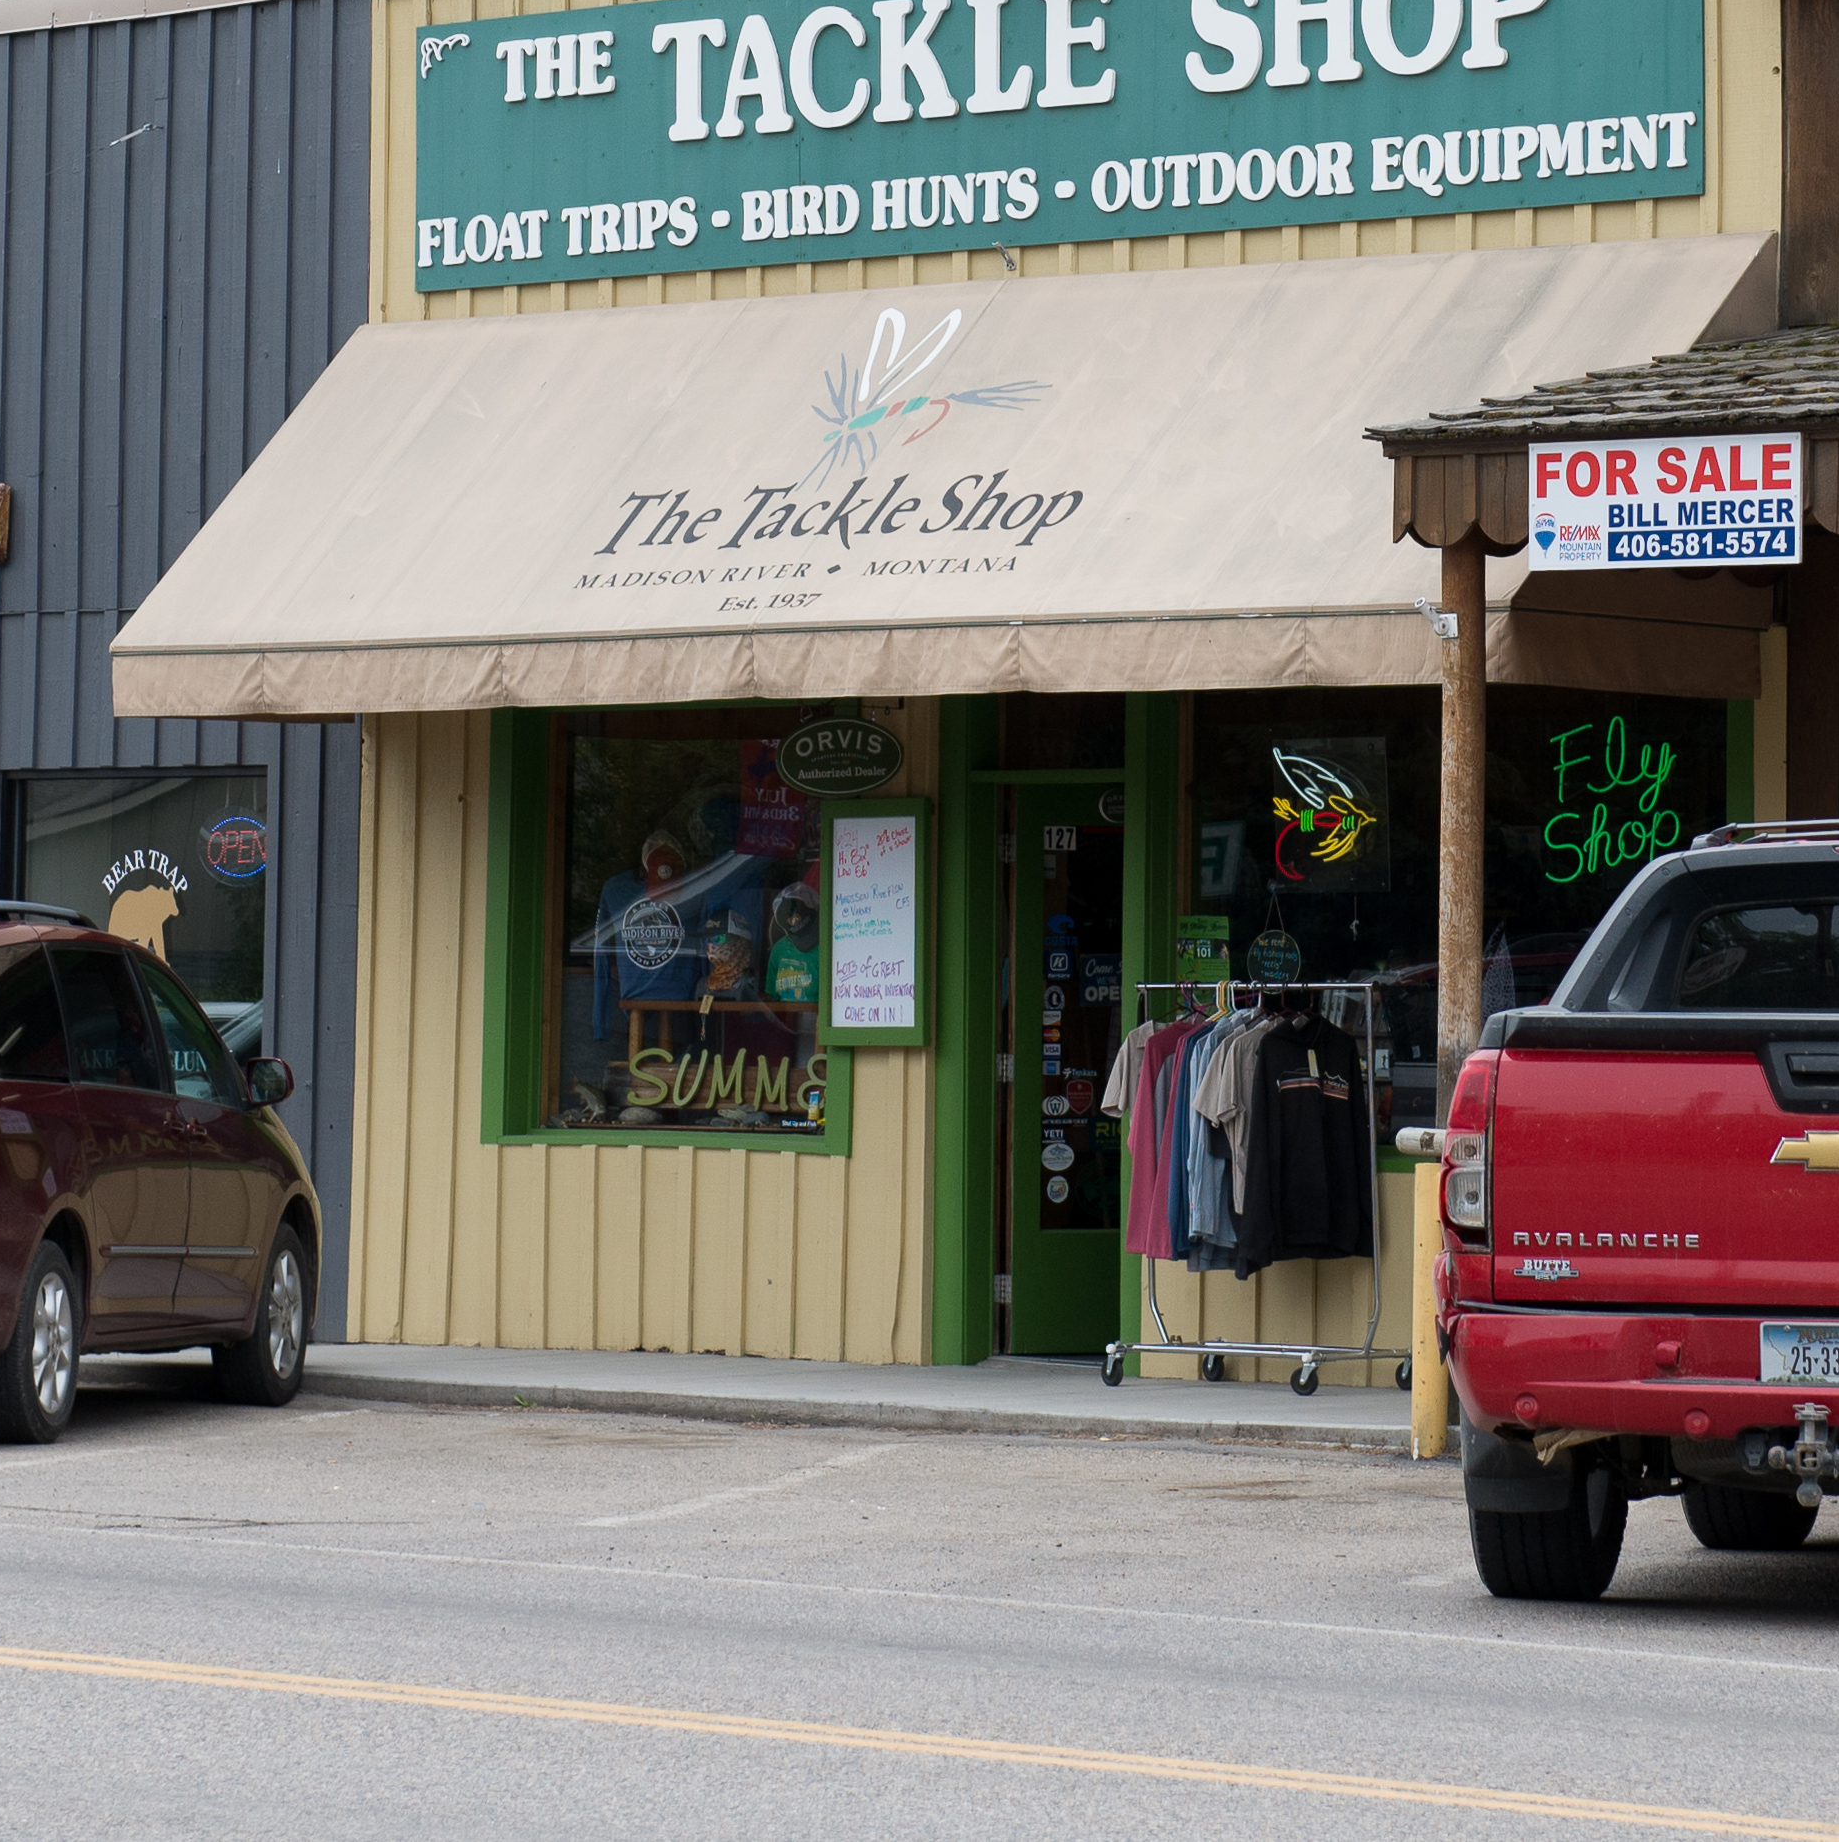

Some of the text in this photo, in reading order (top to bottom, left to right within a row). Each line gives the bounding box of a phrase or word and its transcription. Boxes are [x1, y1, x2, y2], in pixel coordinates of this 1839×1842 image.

[496, 30, 616, 103] THE
[417, 111, 1697, 268] FLOAT TRIPS BIRD HUNTS OUTDOOR EQUIPMENT
[1535, 442, 1793, 499] FOR SALE
[593, 467, 1085, 556] The Tackle Shop
[1608, 497, 1795, 528] BILL MERCER
[1559, 523, 1601, 542] RE/MAX
[1614, 529, 1788, 558] 406-581-5574
[1559, 542, 1602, 552] MOUNTAIN
[1559, 552, 1602, 562] PROPERTY
[572, 556, 1019, 590] MADISON RIVER MONTANA
[717, 592, 823, 612] Est. 1937
[795, 729, 883, 757] ORVIS
[798, 765, 887, 779] Authorized Dealer
[1550, 715, 1677, 813] Fly
[207, 829, 268, 865] OPEN
[1046, 827, 1074, 849] 127
[1544, 803, 1680, 883] Shop
[101, 848, 189, 896] BEAR TRAP
[661, 927, 685, 938] RIVER
[1044, 937, 1078, 946] COSTA
[629, 949, 674, 966] MONTANA
[1197, 947, 1211, 958] 101
[1085, 986, 1122, 1002] OPE
[627, 1047, 827, 1111] SUMME
[1043, 1128, 1064, 1138] YETI
[1513, 1231, 1701, 1249] AVALANCHE
[1523, 1259, 1571, 1272] BUTTE
